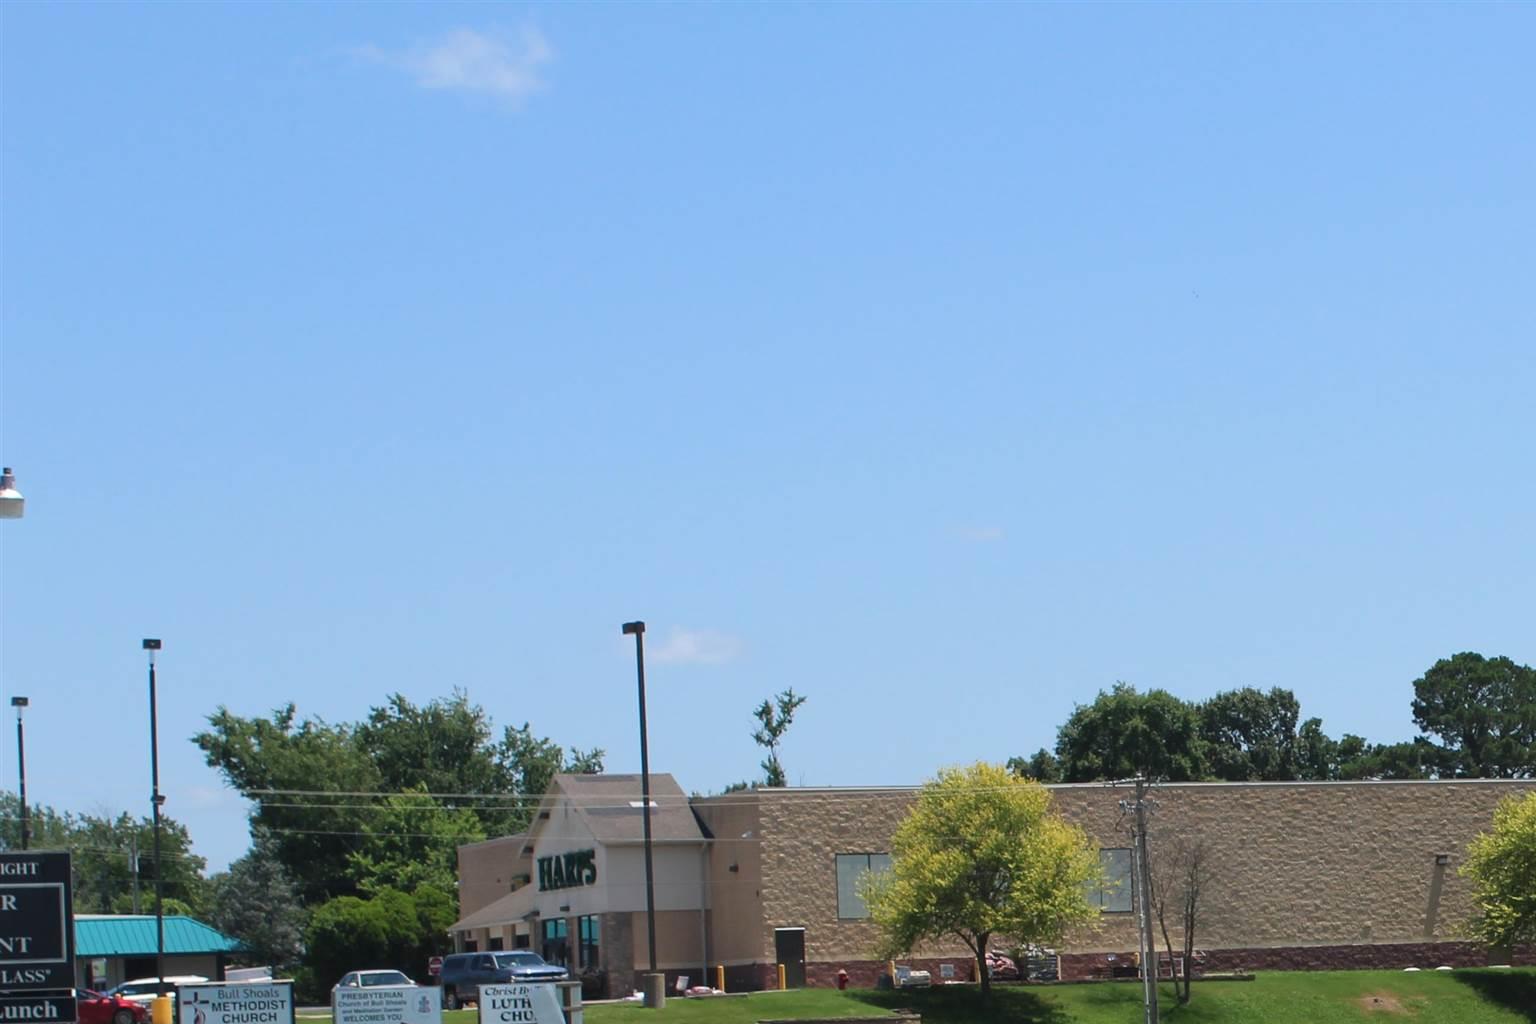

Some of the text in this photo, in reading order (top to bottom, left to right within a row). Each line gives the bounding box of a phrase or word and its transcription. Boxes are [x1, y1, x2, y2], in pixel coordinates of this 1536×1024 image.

[218, 988, 280, 999] Bull Shoals
[341, 991, 403, 1000] PRESBYTERIAN
[211, 1000, 287, 1012] METHODIST
[222, 1012, 278, 1024] CHURCH
[500, 1010, 537, 1022] CHU
